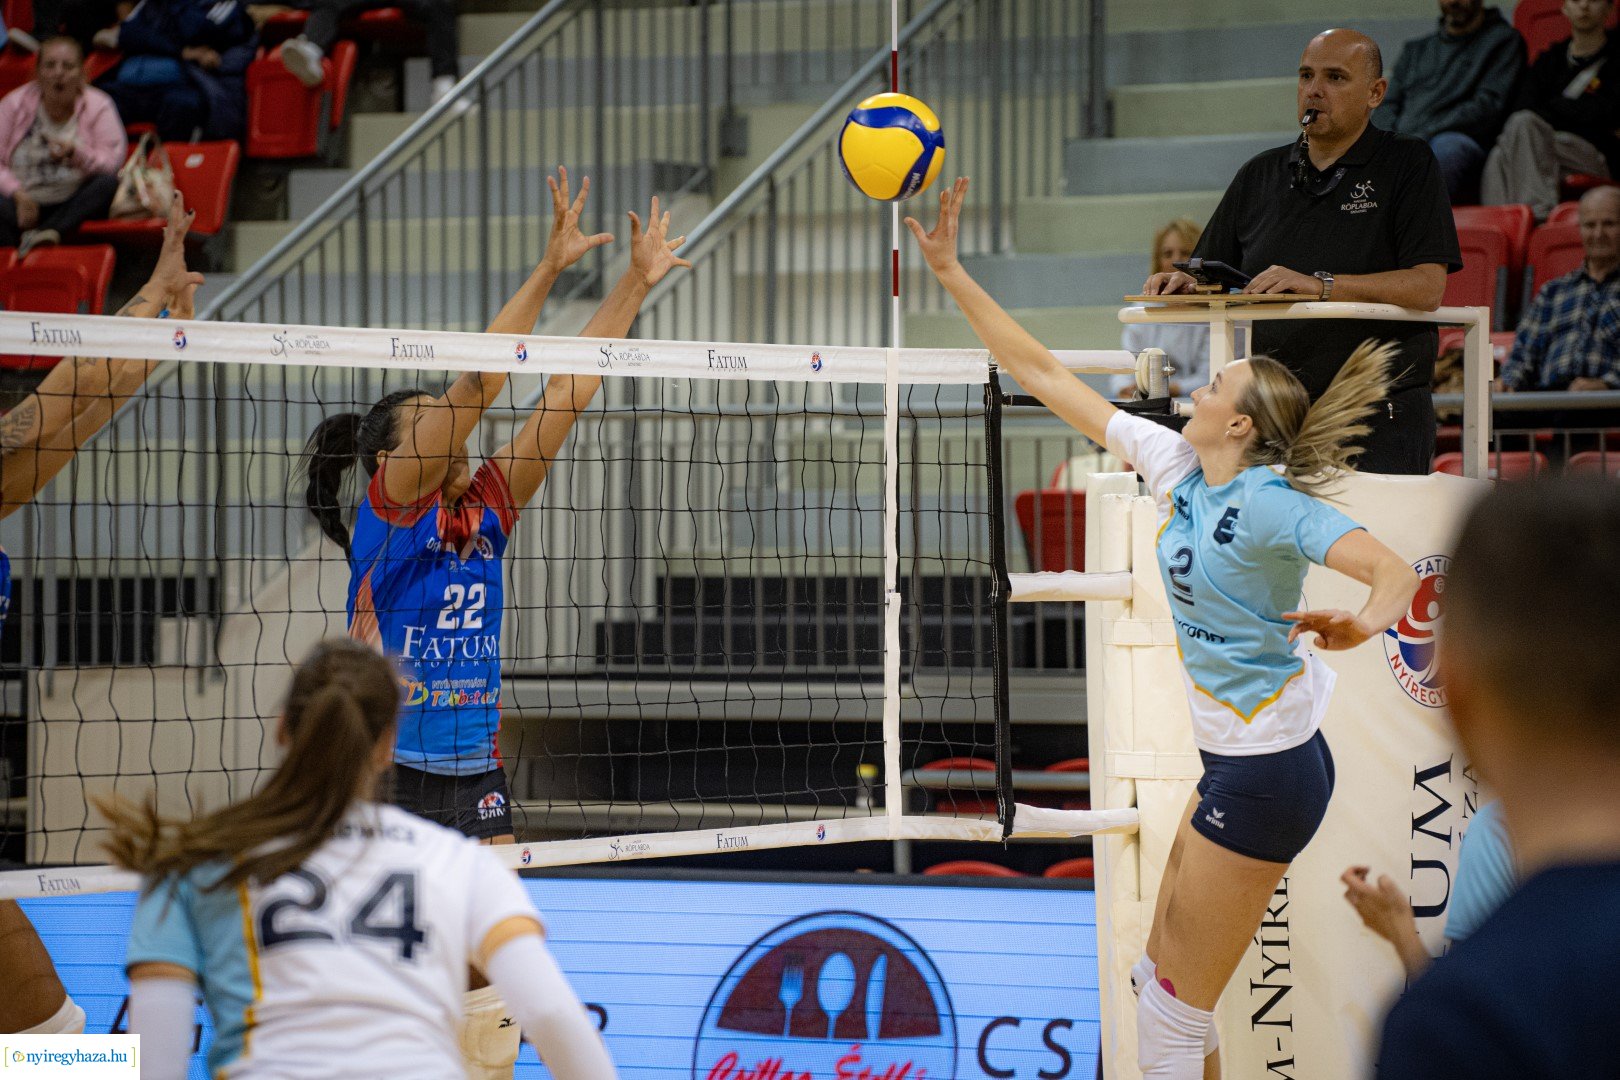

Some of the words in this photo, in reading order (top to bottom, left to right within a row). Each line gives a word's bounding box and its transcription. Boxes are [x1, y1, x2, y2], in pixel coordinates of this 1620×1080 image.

[31, 321, 82, 345] FATUM
[390, 337, 434, 358] FATUM
[707, 349, 748, 369] FATUM
[1168, 545, 1194, 598] 2
[436, 583, 487, 630] 22
[402, 624, 498, 660] FATUM
[1390, 653, 1447, 705] NYÍREGY
[716, 833, 749, 849] FATUM
[260, 868, 426, 960] 24
